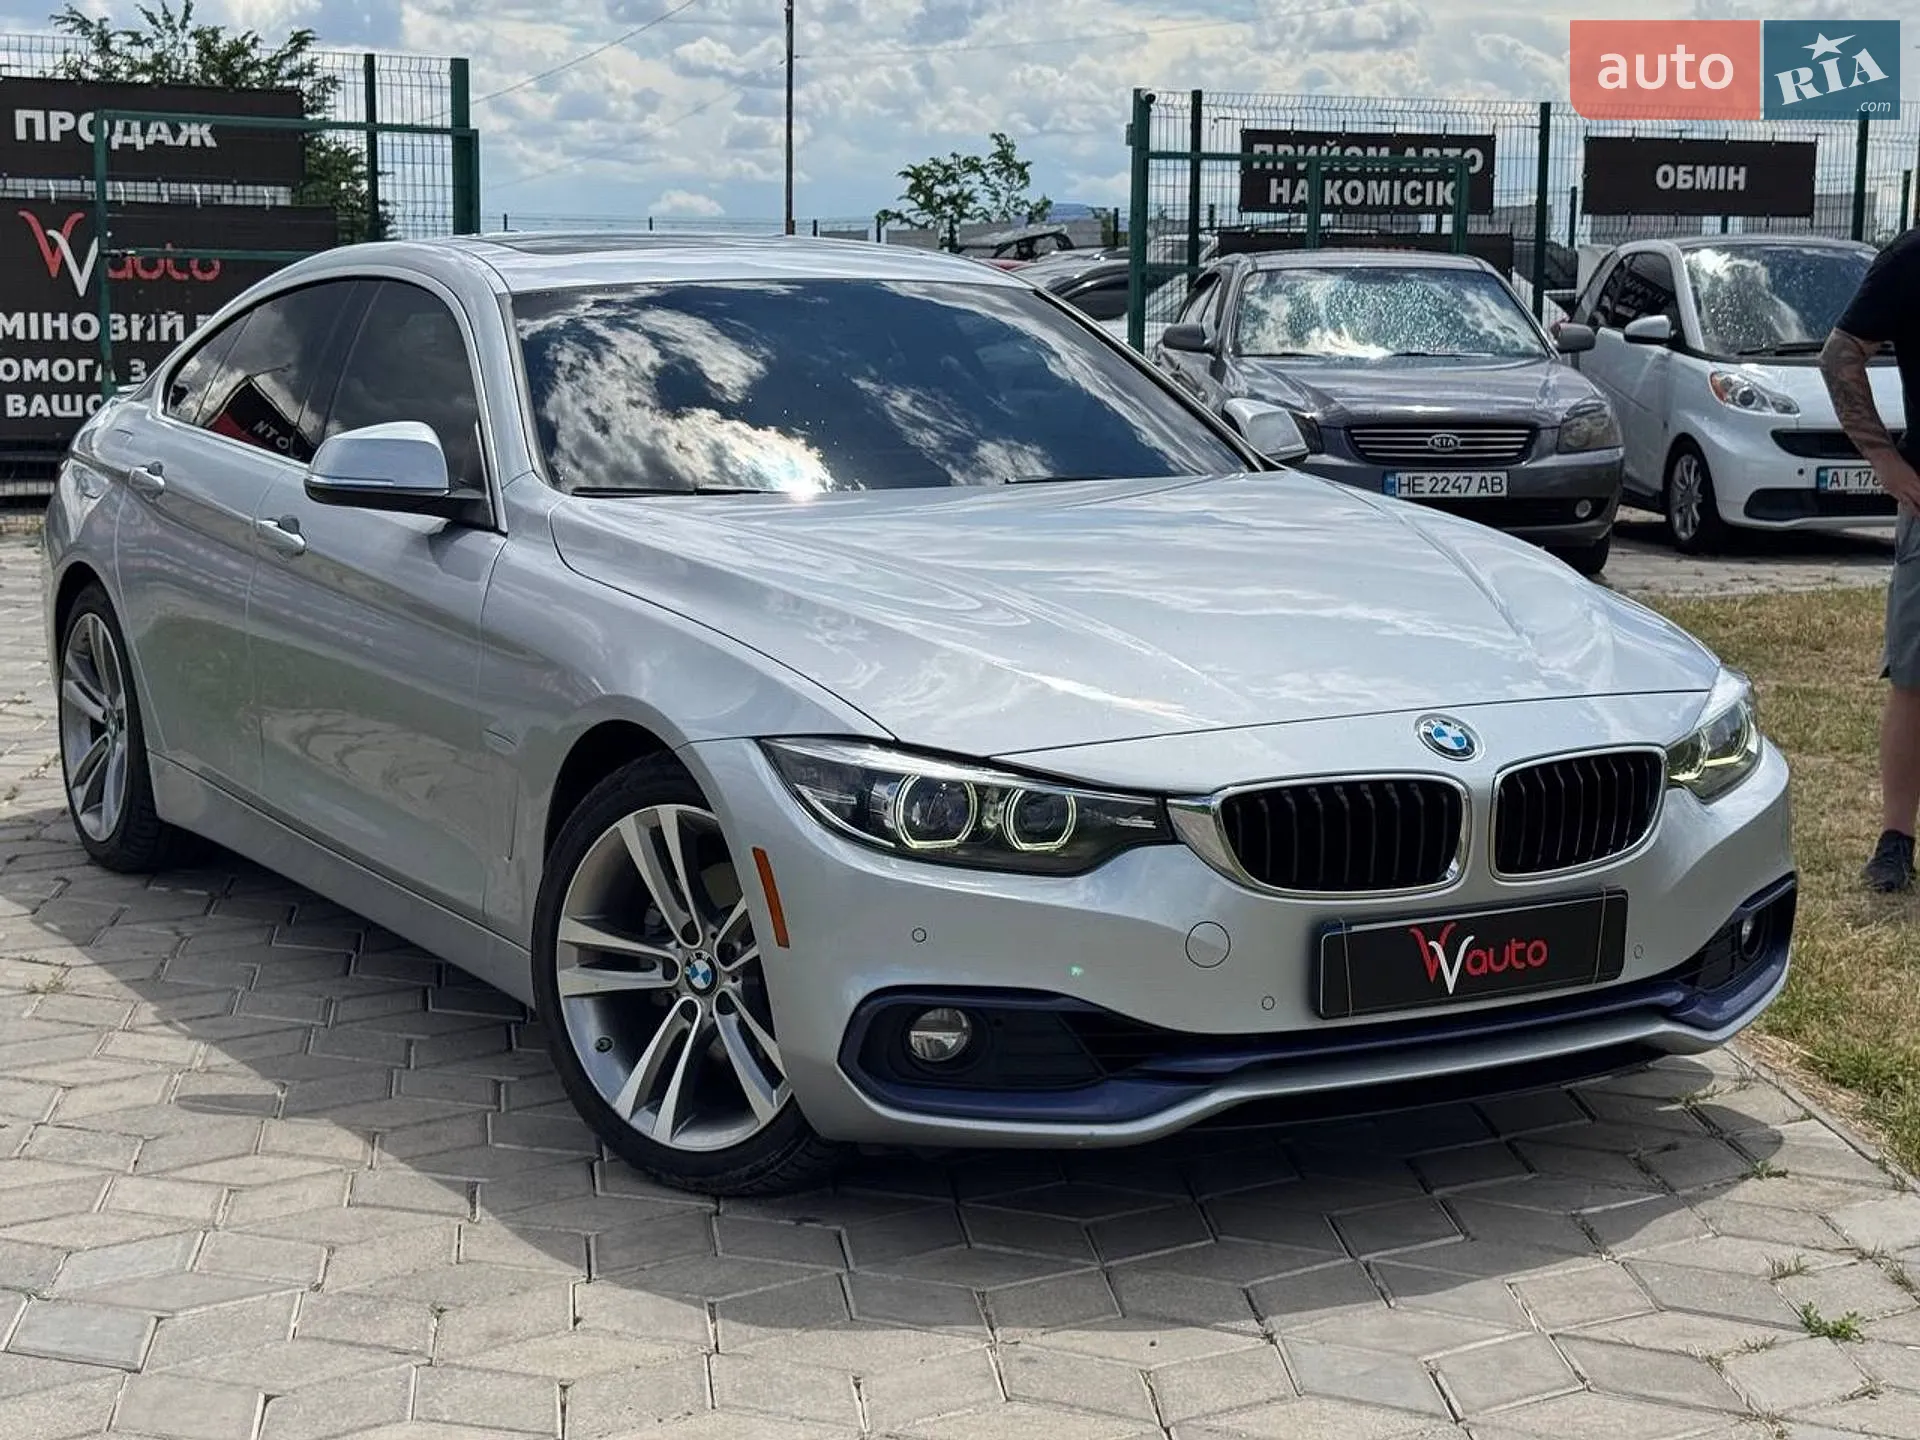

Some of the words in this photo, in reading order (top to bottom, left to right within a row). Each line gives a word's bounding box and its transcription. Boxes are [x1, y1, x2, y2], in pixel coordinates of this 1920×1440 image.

[14, 109, 217, 150] ПРОДАЖ
[1656, 164, 1748, 190] ОБМІН
[1269, 178, 1308, 204] НА
[1398, 476, 1424, 494] HE
[1429, 476, 1473, 494] 2247
[1477, 476, 1504, 494] AB
